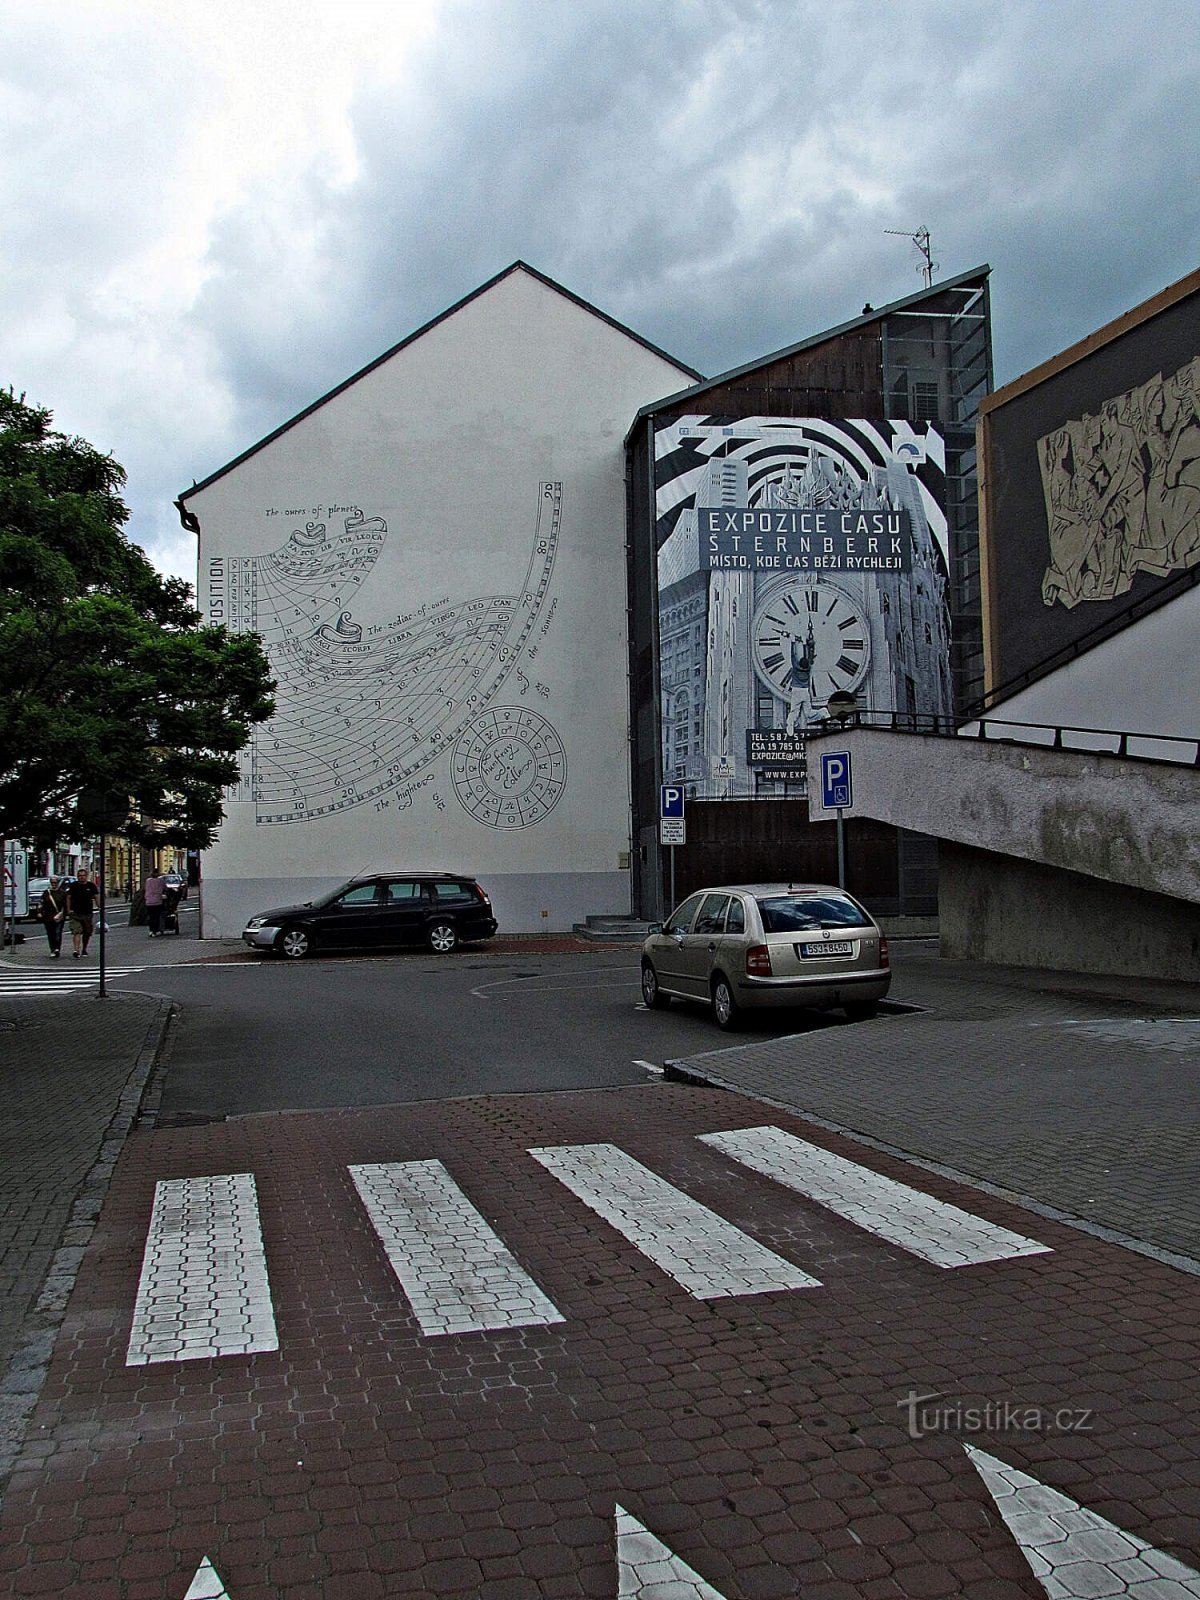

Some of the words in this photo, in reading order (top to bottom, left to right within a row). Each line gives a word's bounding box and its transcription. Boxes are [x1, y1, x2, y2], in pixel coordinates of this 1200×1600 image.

[265, 508, 279, 517] The
[312, 504, 322, 519] of
[709, 512, 827, 533] EXPOZICE
[841, 511, 900, 534] ČASU
[709, 533, 902, 553] ŠTERNBERK
[709, 553, 751, 569] MÍSTO,
[756, 556, 781, 567] KDE
[785, 554, 809, 568] ČAS
[814, 554, 841, 568] BĚŽÍ
[846, 557, 902, 569] RYCHLEJI
[468, 602, 484, 612] LEO
[367, 625, 382, 635] The
[417, 604, 426, 616] of
[430, 611, 456, 625] VIRGO
[827, 759, 844, 791] P
[665, 789, 680, 808] P
